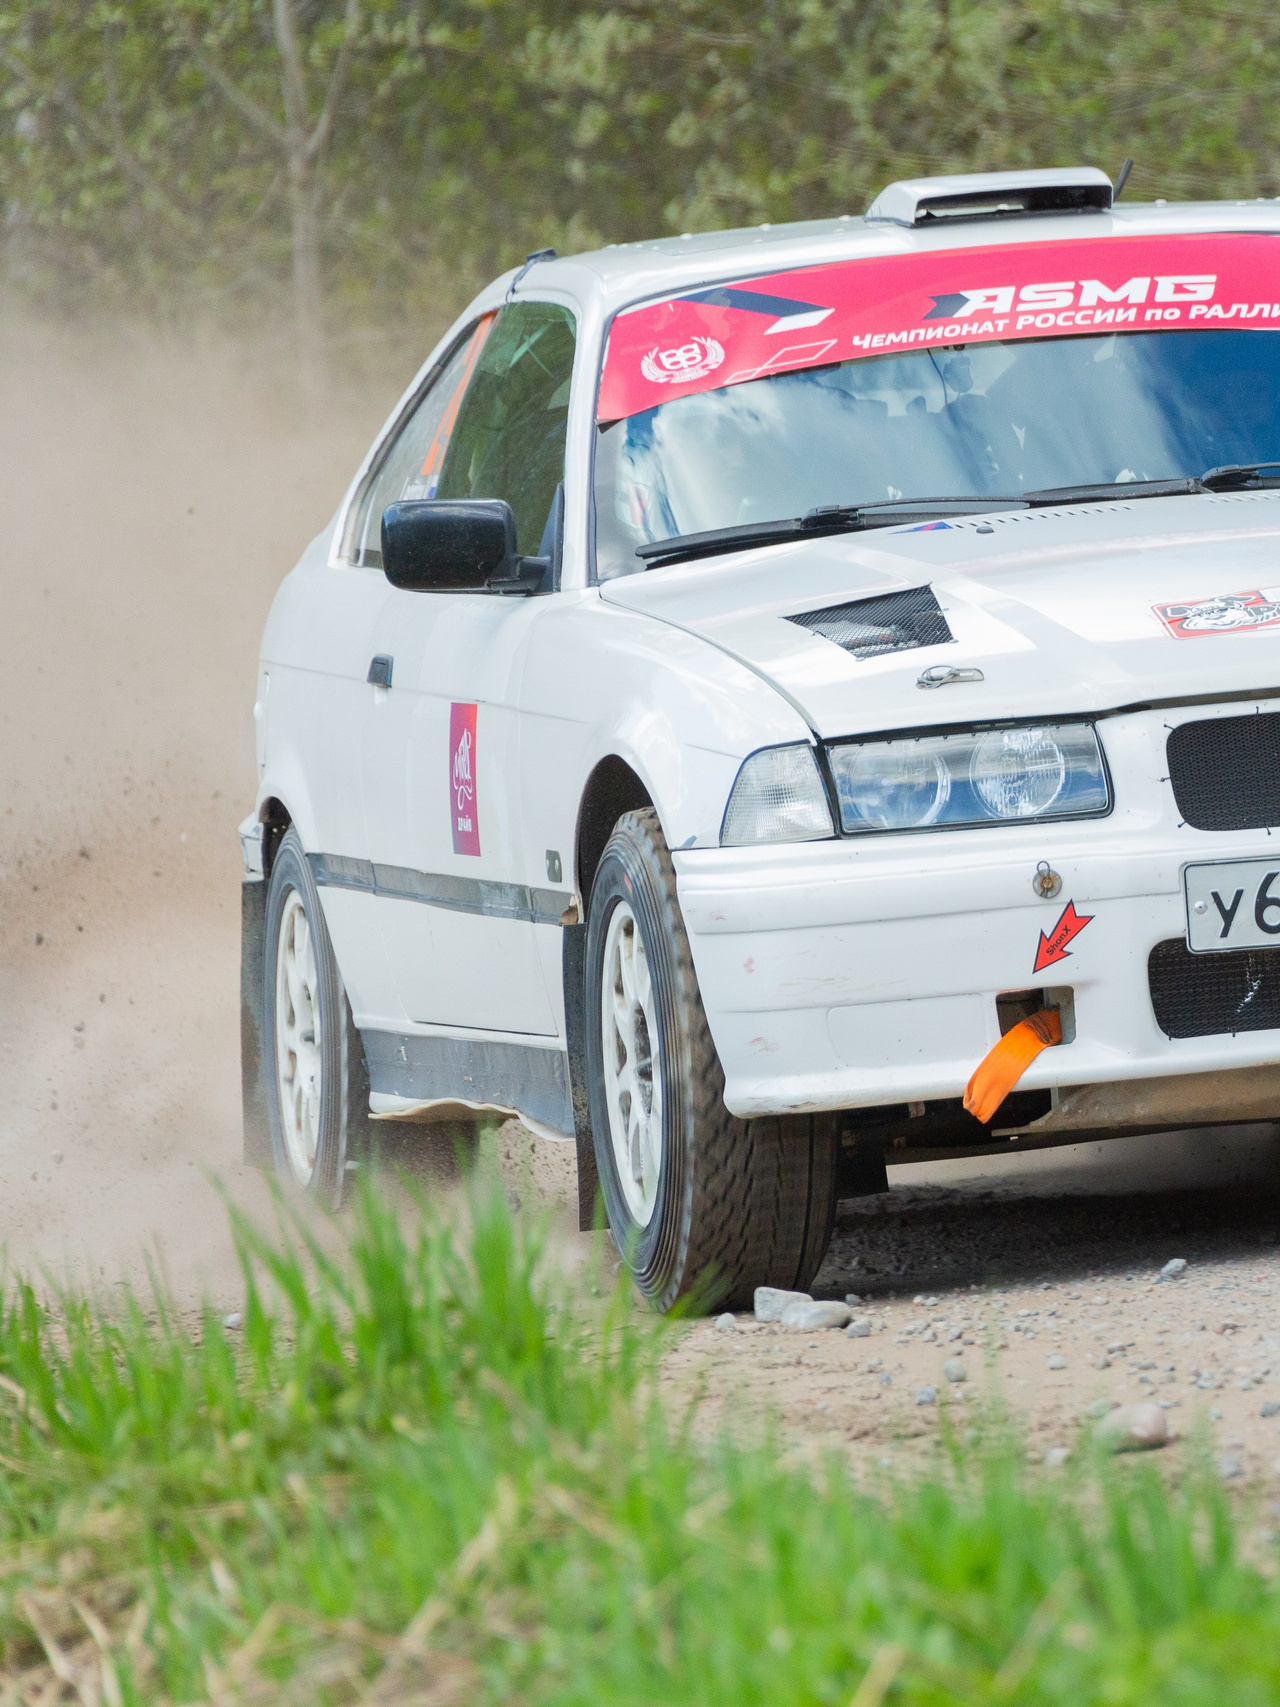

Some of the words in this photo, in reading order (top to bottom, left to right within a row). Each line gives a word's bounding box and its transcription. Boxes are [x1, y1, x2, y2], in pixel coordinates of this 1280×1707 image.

[953, 275, 1217, 318] ASMG
[1015, 307, 1137, 330] РОССИИ
[1045, 924, 1071, 956] ShonX
